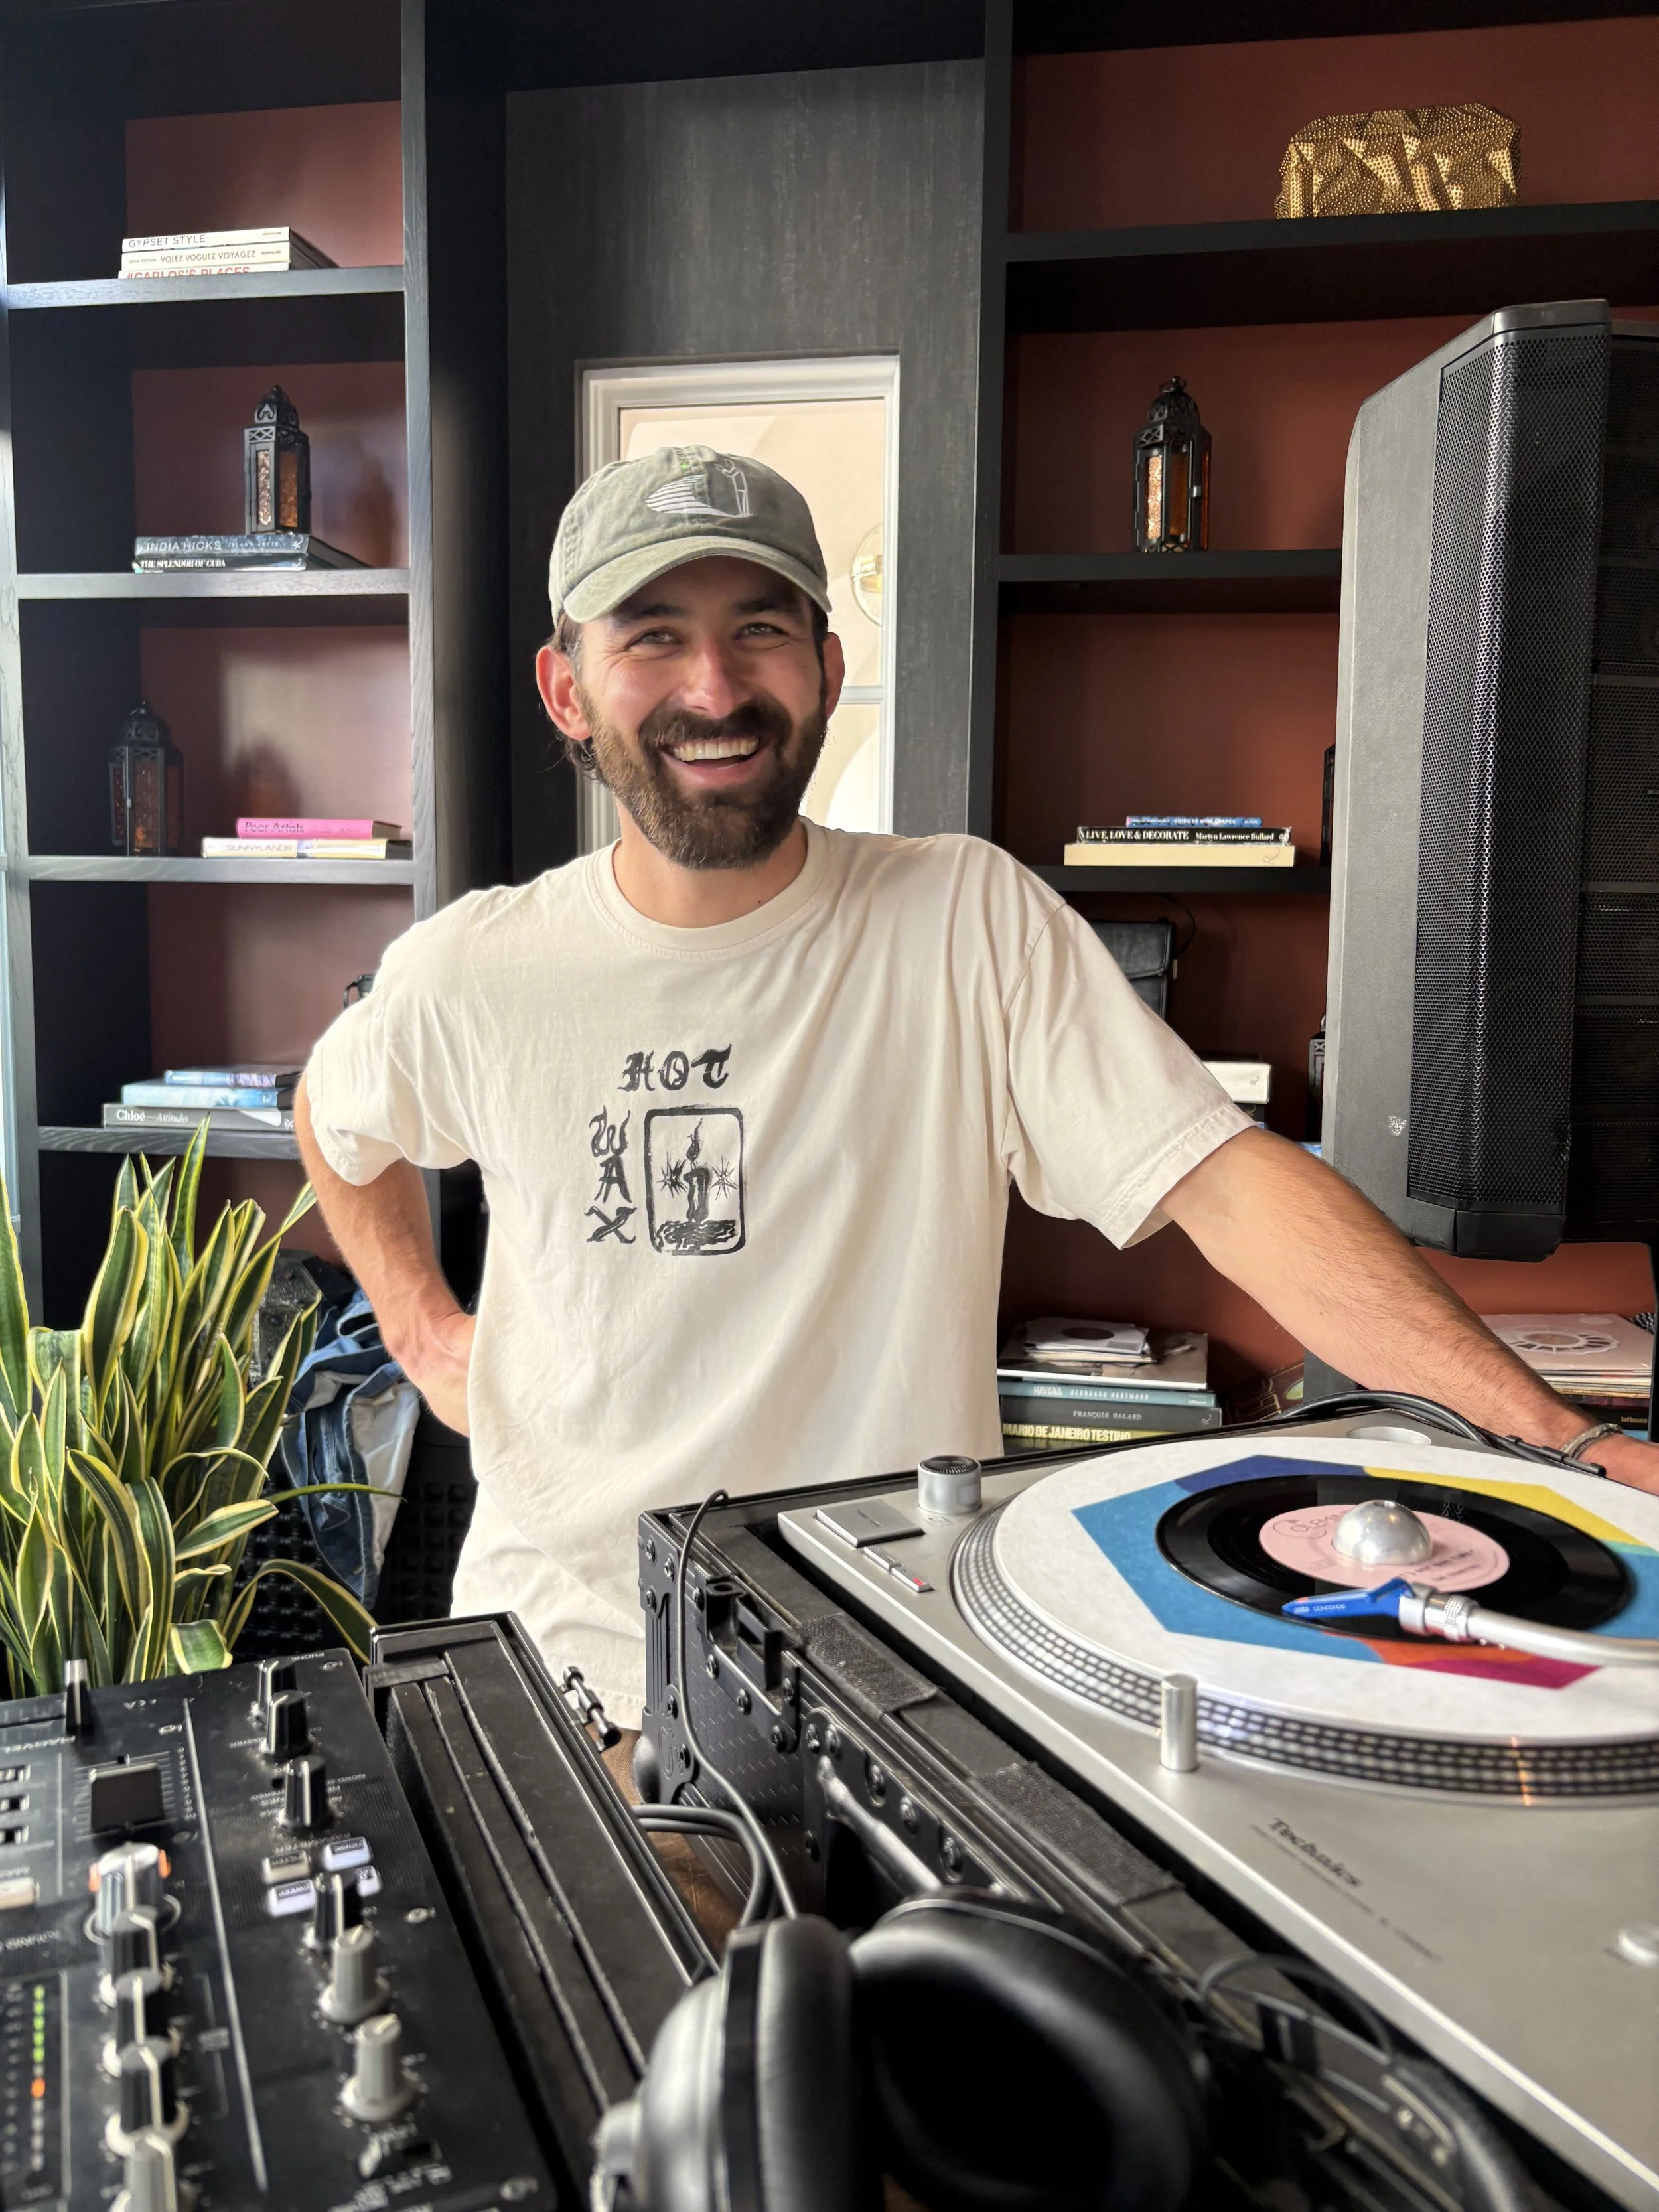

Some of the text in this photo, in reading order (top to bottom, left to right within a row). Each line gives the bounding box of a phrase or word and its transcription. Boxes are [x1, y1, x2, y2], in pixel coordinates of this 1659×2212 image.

[128, 234, 206, 248] GYPSET STYLE
[160, 255, 184, 263] VOLEZ
[185, 252, 216, 261] VOGUEZ
[218, 250, 257, 260] VOYAGEZ
[146, 542, 180, 552] INDIA
[182, 540, 222, 552] HICKS
[244, 821, 269, 832] Poor
[270, 821, 305, 834] Artists
[1110, 830, 1133, 840] LOVE
[1133, 830, 1141, 840] &
[1142, 830, 1189, 840] DECORATE
[1195, 832, 1218, 842] Martyn
[1219, 832, 1250, 841] Lawrence
[1250, 832, 1274, 841] Bullard
[617, 1043, 732, 1092] HOT
[116, 1108, 146, 1122] Chloé
[584, 1105, 638, 1244] WAX
[1033, 1385, 1063, 1397] HAVANA
[1003, 1423, 1132, 1443] MARIO DE JANEIRO TESTINO
